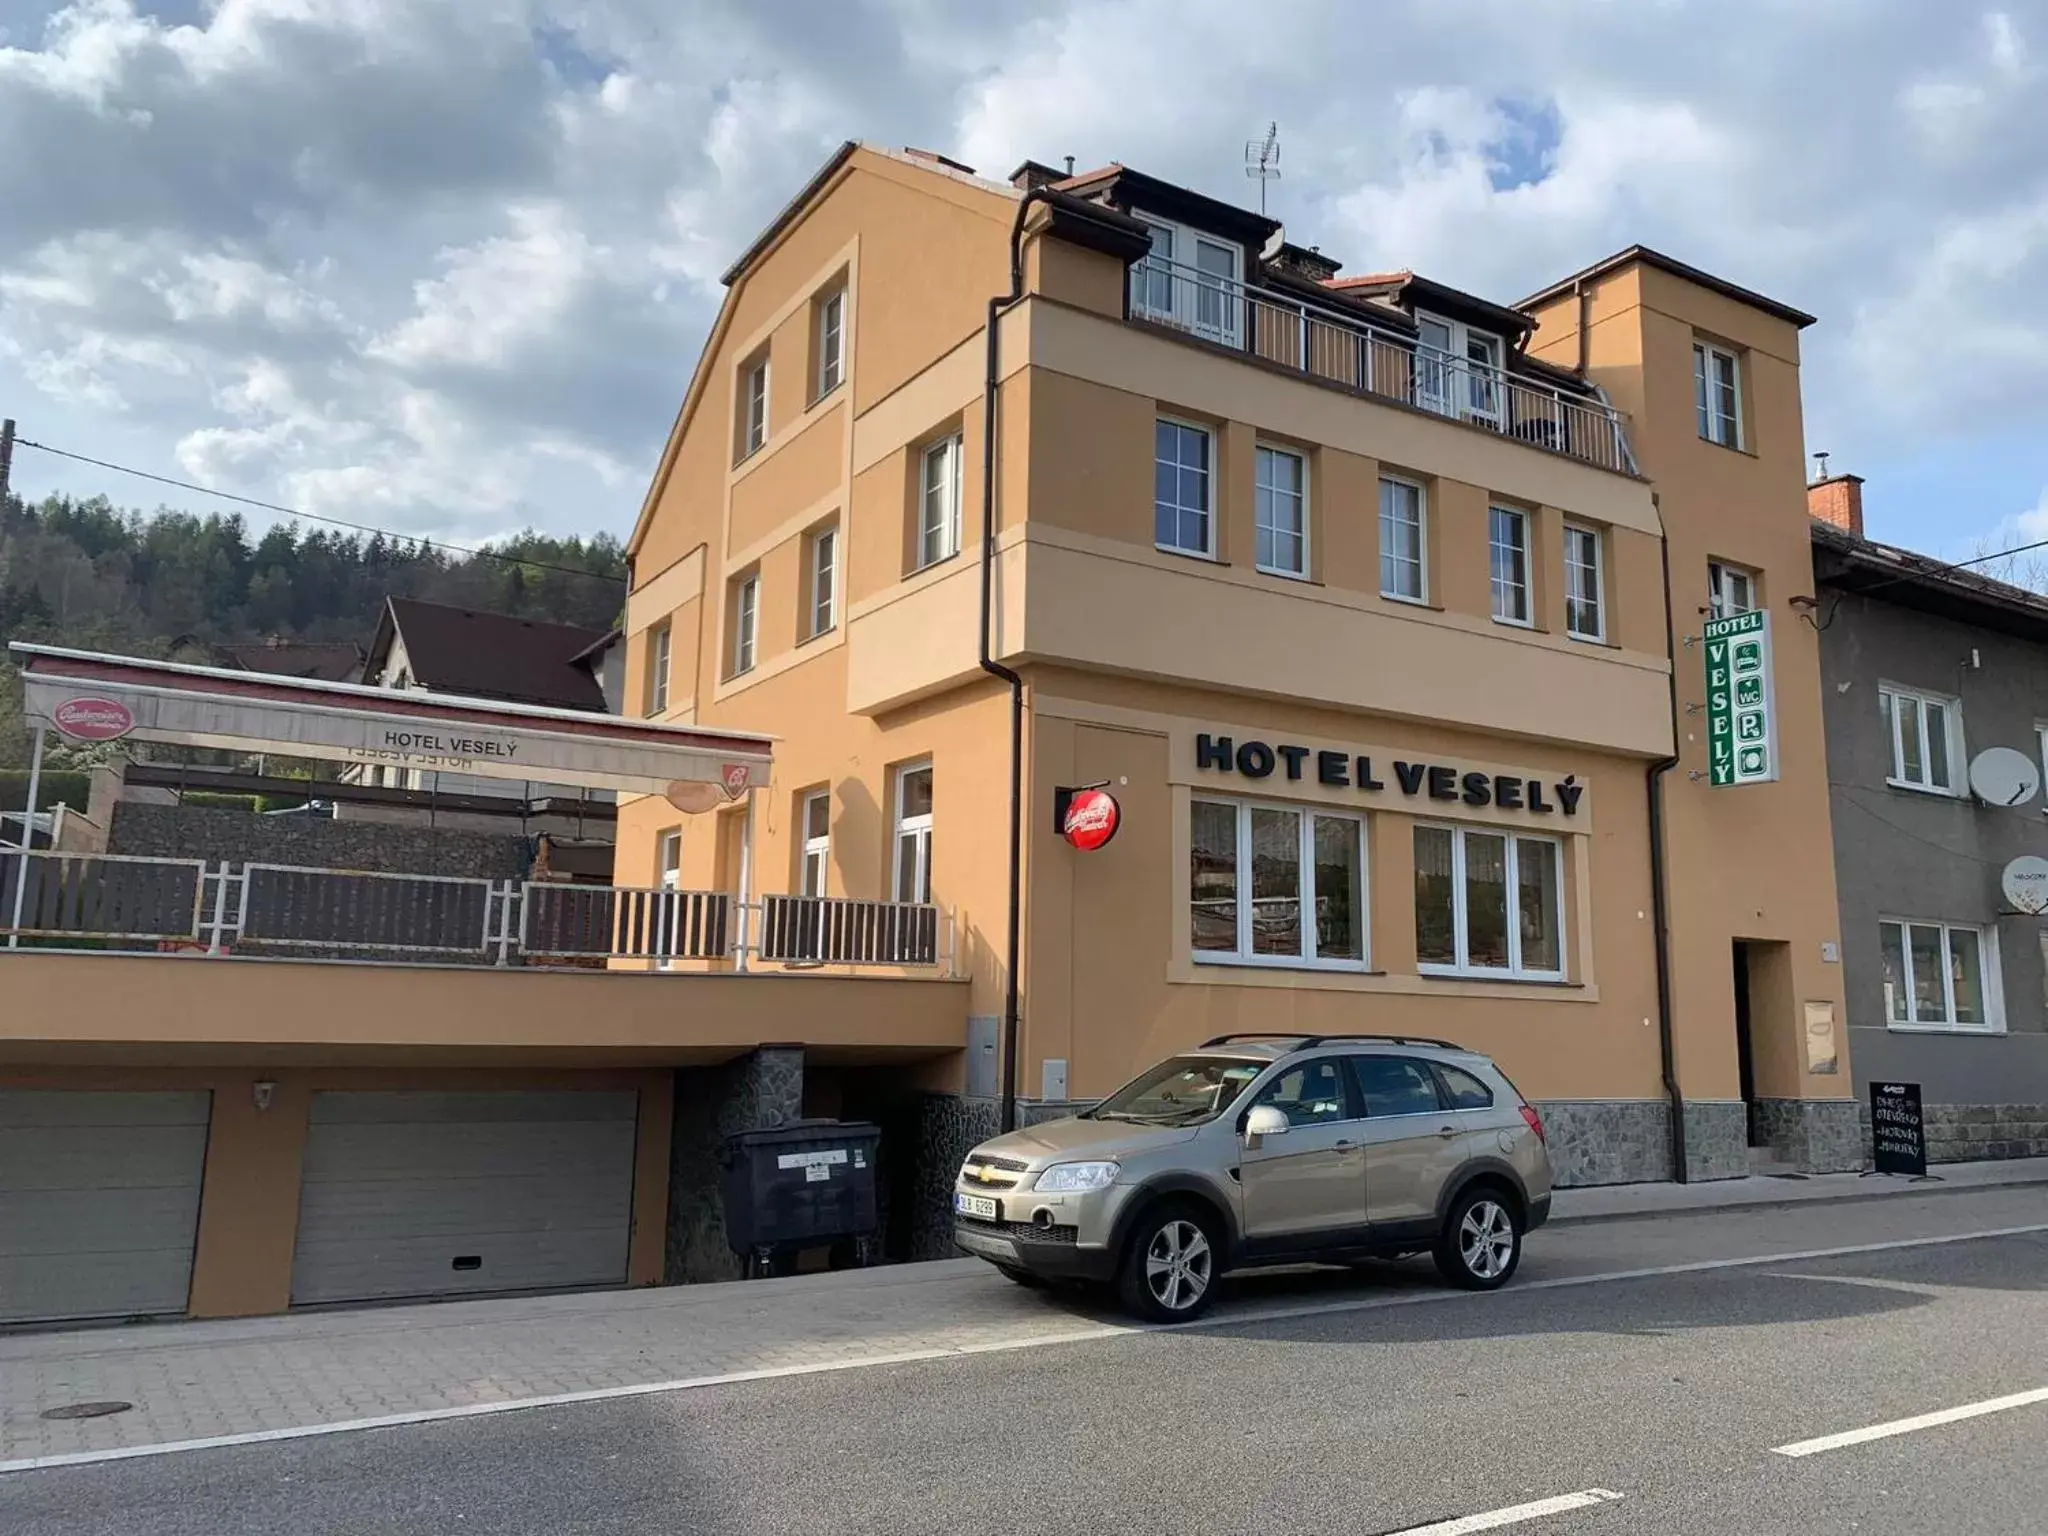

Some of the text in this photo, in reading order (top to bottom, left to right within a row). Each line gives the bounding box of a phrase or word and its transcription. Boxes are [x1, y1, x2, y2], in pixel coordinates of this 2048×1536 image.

[1706, 614, 1761, 637] HOTEL
[1739, 690, 1760, 704] WC
[1709, 643, 1732, 784] VESELÝ
[385, 731, 518, 757] HOTEL VESELÝ
[1196, 733, 1584, 815] HOTEL VESELÝ
